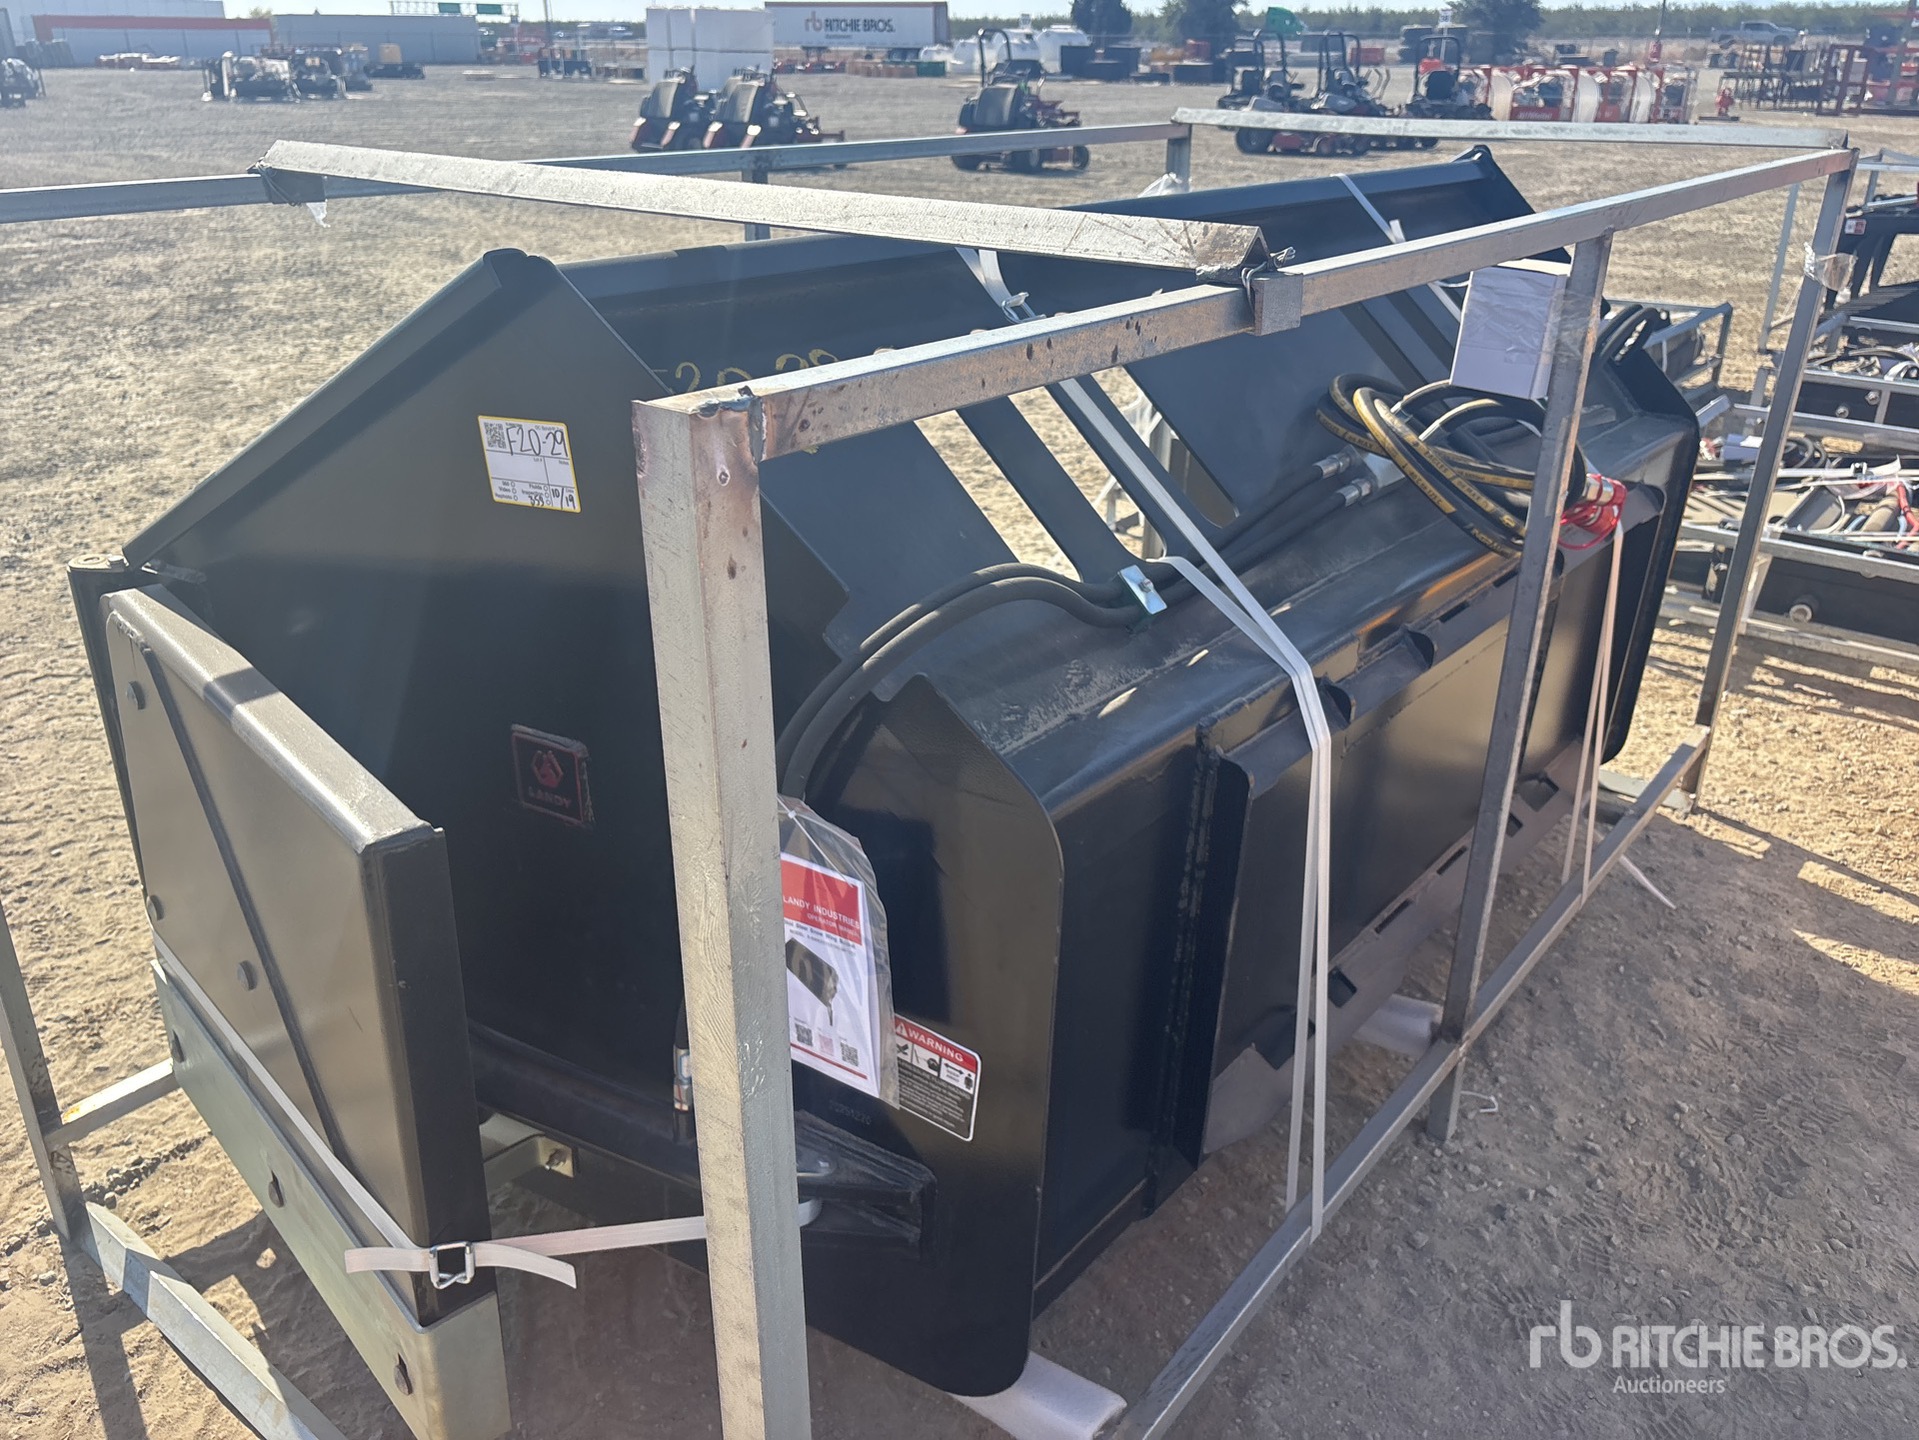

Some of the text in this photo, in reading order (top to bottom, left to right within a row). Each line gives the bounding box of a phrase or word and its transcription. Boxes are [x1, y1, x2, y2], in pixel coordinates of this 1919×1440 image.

[825, 18, 861, 32] RITCHIE
[863, 18, 896, 33] BROS.
[506, 426, 569, 457] F20-29
[813, 904, 860, 929] INDUSTRIES
[908, 1027, 964, 1062] WARNING
